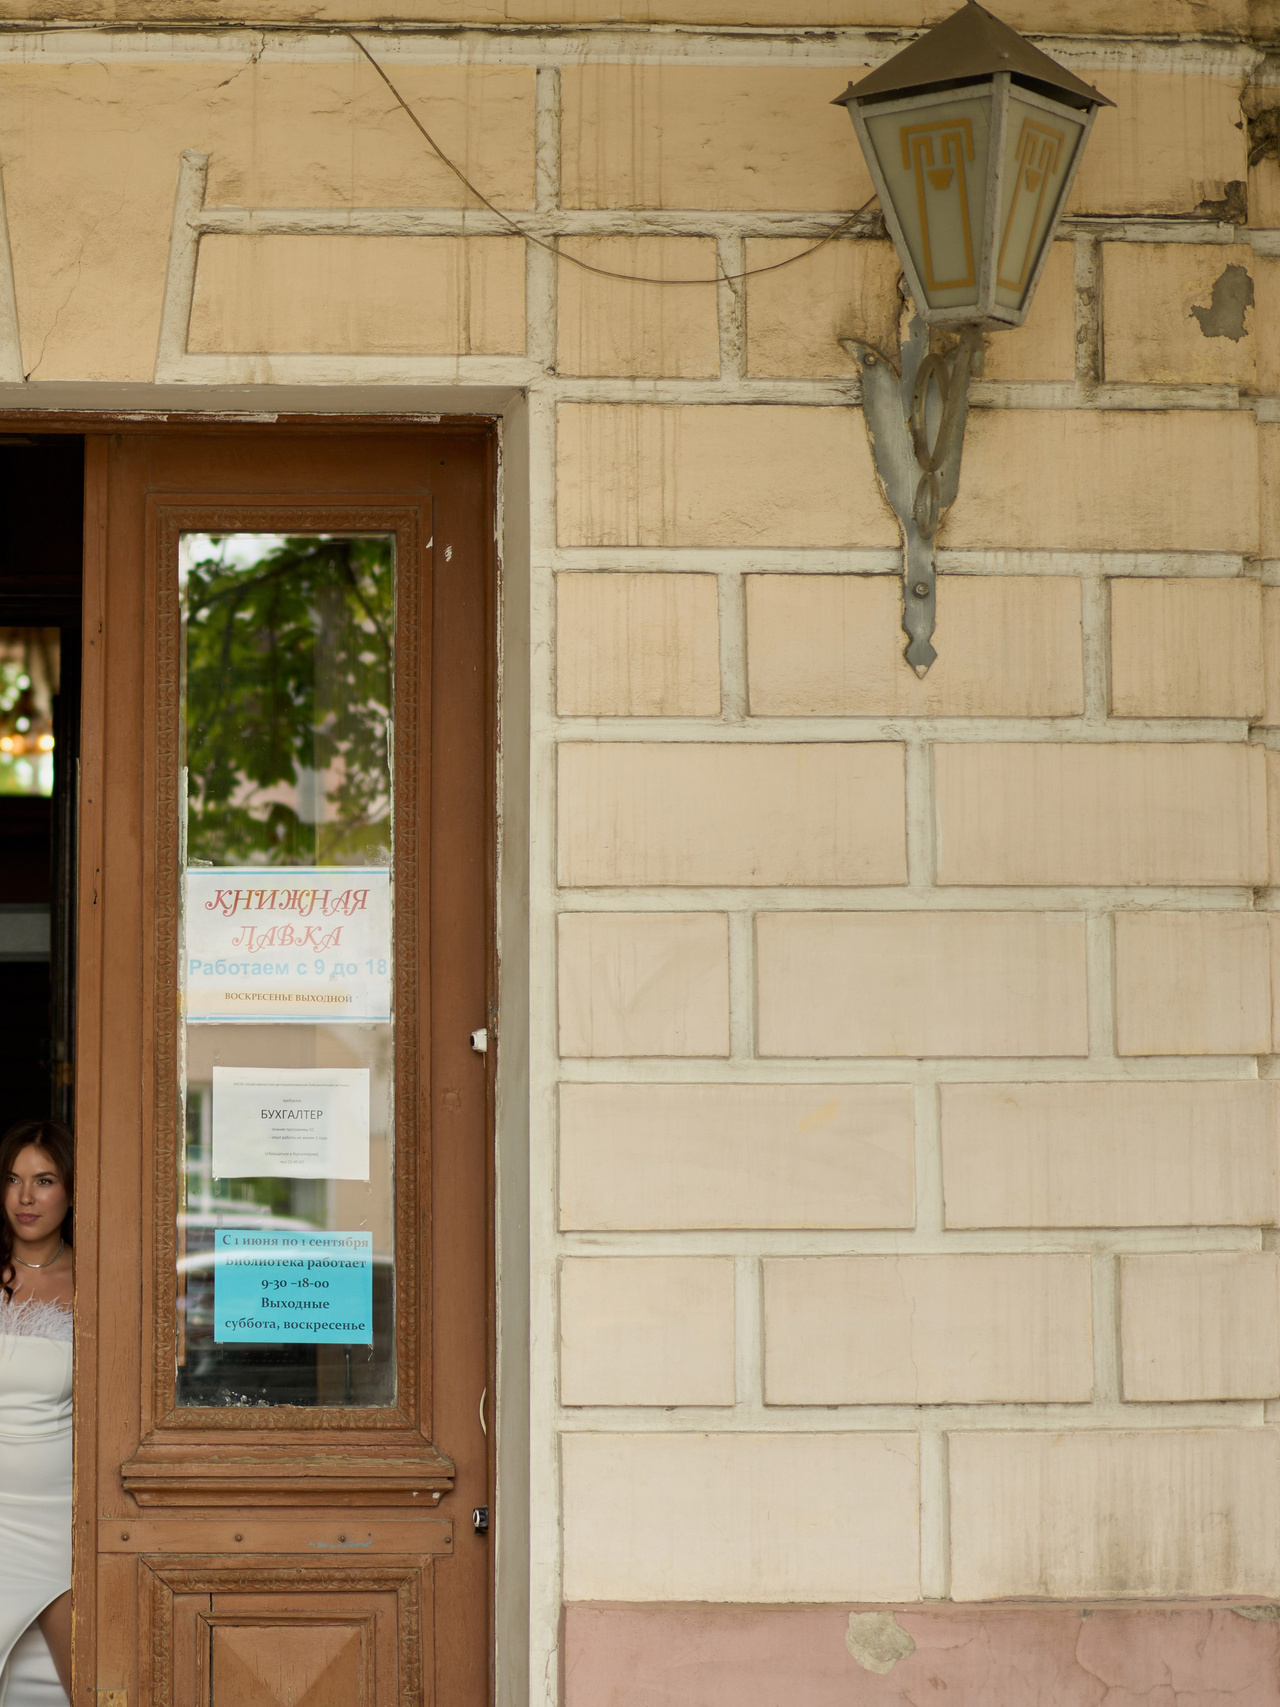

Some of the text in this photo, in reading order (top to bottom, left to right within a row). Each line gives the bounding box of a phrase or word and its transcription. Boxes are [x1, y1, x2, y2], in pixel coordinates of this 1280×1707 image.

[204, 888, 370, 918] КНИЖНАЯ
[231, 922, 344, 954] ЛАВКА
[189, 958, 388, 978] Работаем с 9 до 18
[224, 991, 353, 1004] ВОСКРЕСЕНЬЕ ВЫХОДНОЙ
[260, 1109, 324, 1120] БУХГАЛТЕР
[222, 1234, 369, 1250] С 1 июня по 1 сентября
[225, 1255, 366, 1270] Библиотека работает
[261, 1279, 287, 1290] 9-30
[261, 1297, 330, 1310] Выходные
[224, 1317, 366, 1333] суббота, воскресенье
